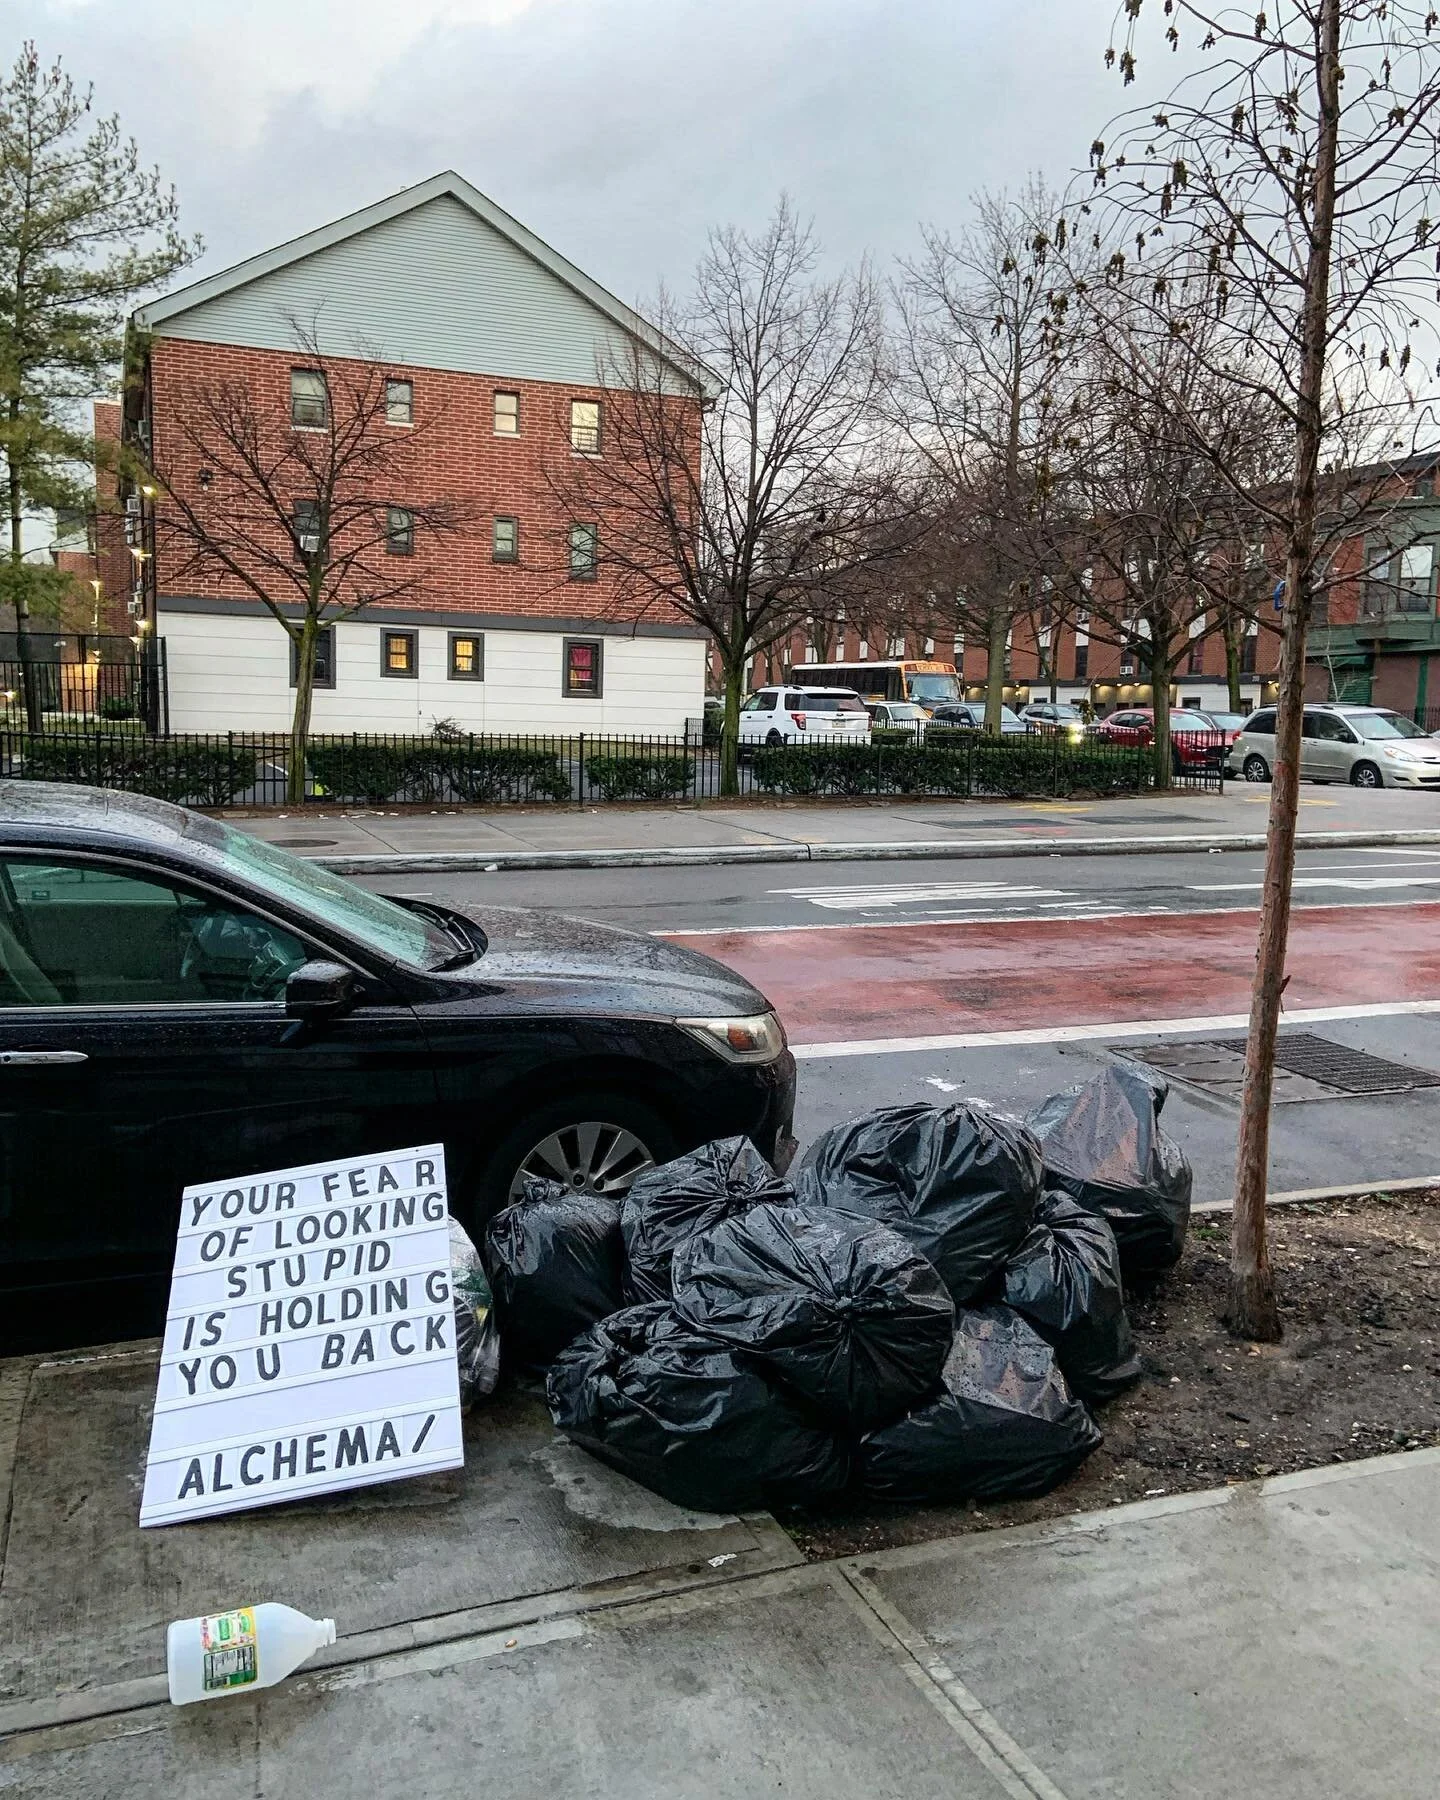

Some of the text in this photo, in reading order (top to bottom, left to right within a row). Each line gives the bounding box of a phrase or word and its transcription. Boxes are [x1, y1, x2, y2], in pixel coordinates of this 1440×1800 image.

[192, 1160, 435, 1226] YOUR FEAR
[200, 1192, 444, 1262] OF LOOKING
[228, 1241, 391, 1299] STUPID
[183, 1271, 450, 1351] IS HOLDING
[179, 1315, 446, 1396] YOU BACK
